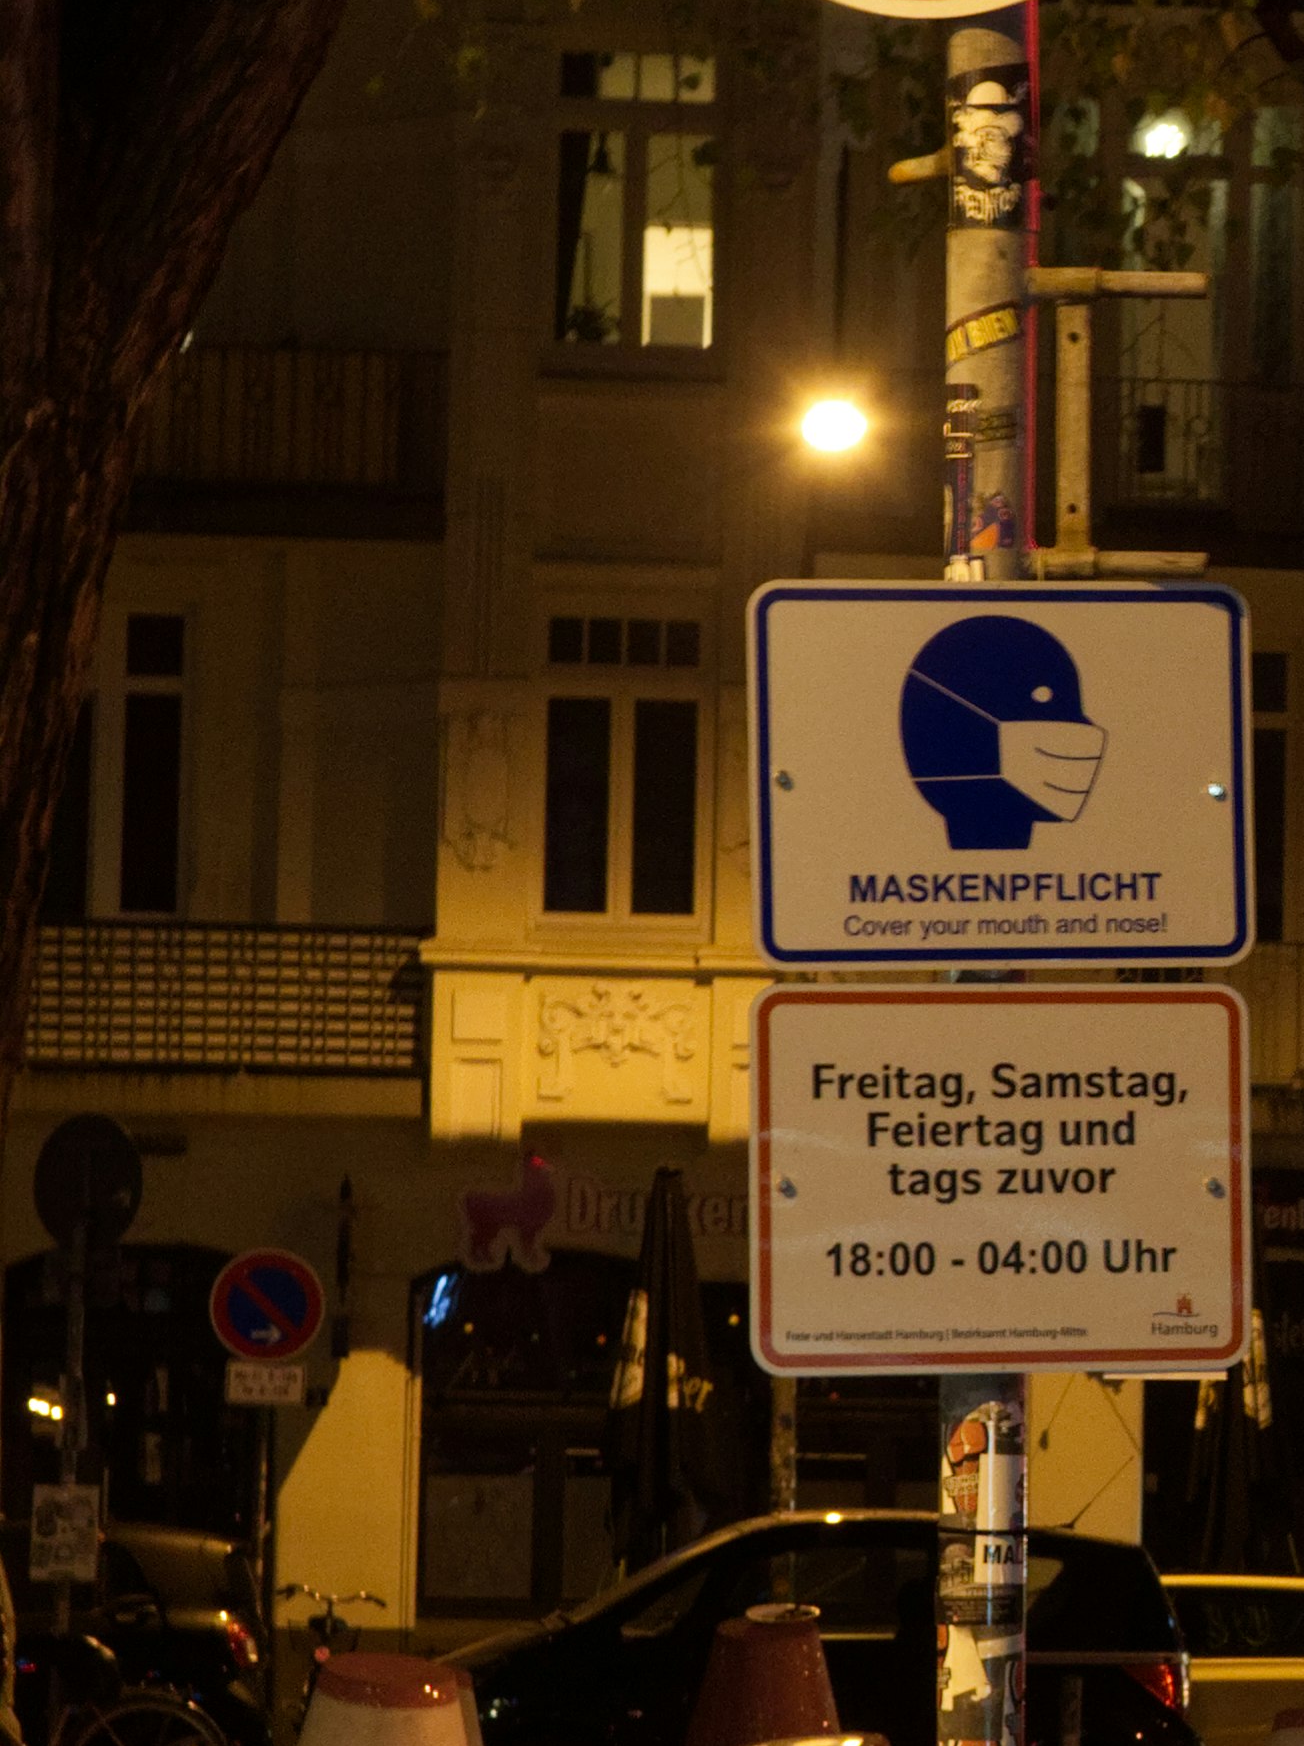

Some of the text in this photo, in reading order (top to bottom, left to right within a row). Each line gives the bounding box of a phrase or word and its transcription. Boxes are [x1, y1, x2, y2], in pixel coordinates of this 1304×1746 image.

[850, 873, 1161, 902] MASKENPFLICHT
[844, 913, 1168, 940] Cover your mouth and nose!
[811, 1062, 1188, 1107] Freitag, Samstag,
[867, 1110, 1136, 1154] Feiertag und
[889, 1163, 1115, 1204] tags zuvor
[826, 1241, 936, 1277] 18:00
[977, 1240, 1088, 1274] 04:00
[1103, 1239, 1176, 1274] Uhr
[1151, 1321, 1218, 1339] Hamburg
